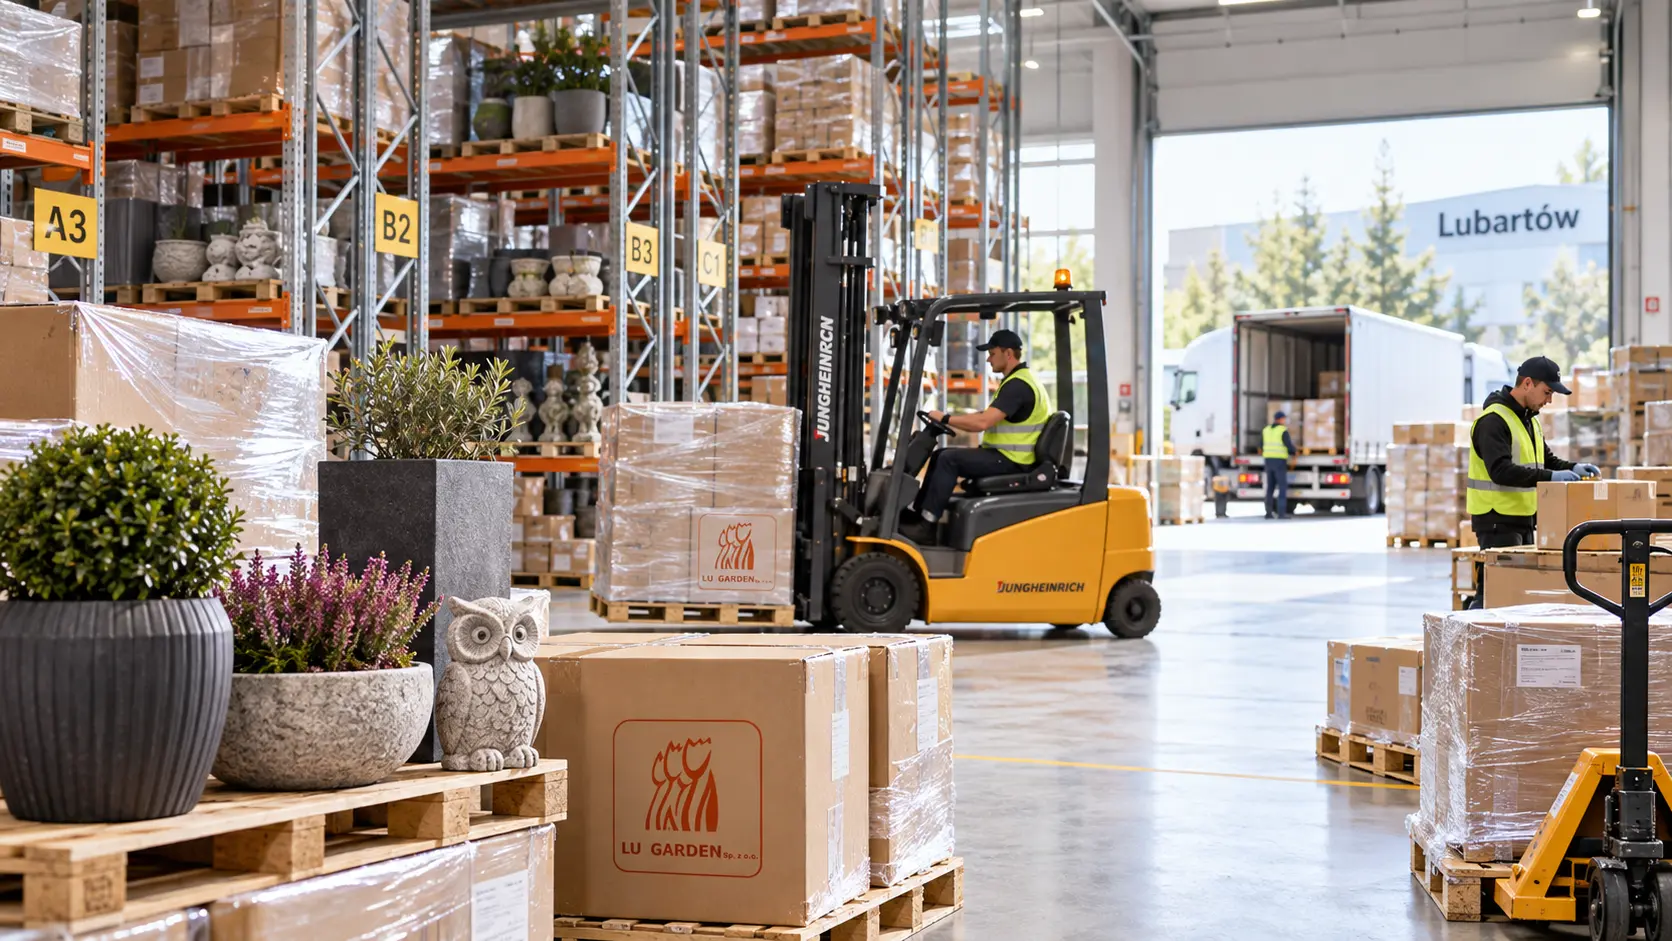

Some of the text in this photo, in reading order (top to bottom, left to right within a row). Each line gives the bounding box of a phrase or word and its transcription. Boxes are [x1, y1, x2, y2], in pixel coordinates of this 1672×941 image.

[45, 205, 87, 244] A3
[383, 209, 411, 244] B2
[1438, 204, 1580, 238] Lubartów
[631, 235, 653, 264] B3
[702, 250, 720, 277] C1
[718, 575, 755, 583] GARDEN
[997, 581, 1085, 593] JUNGHEINRICH
[621, 841, 641, 855] LU
[650, 843, 722, 858] GARDEN
